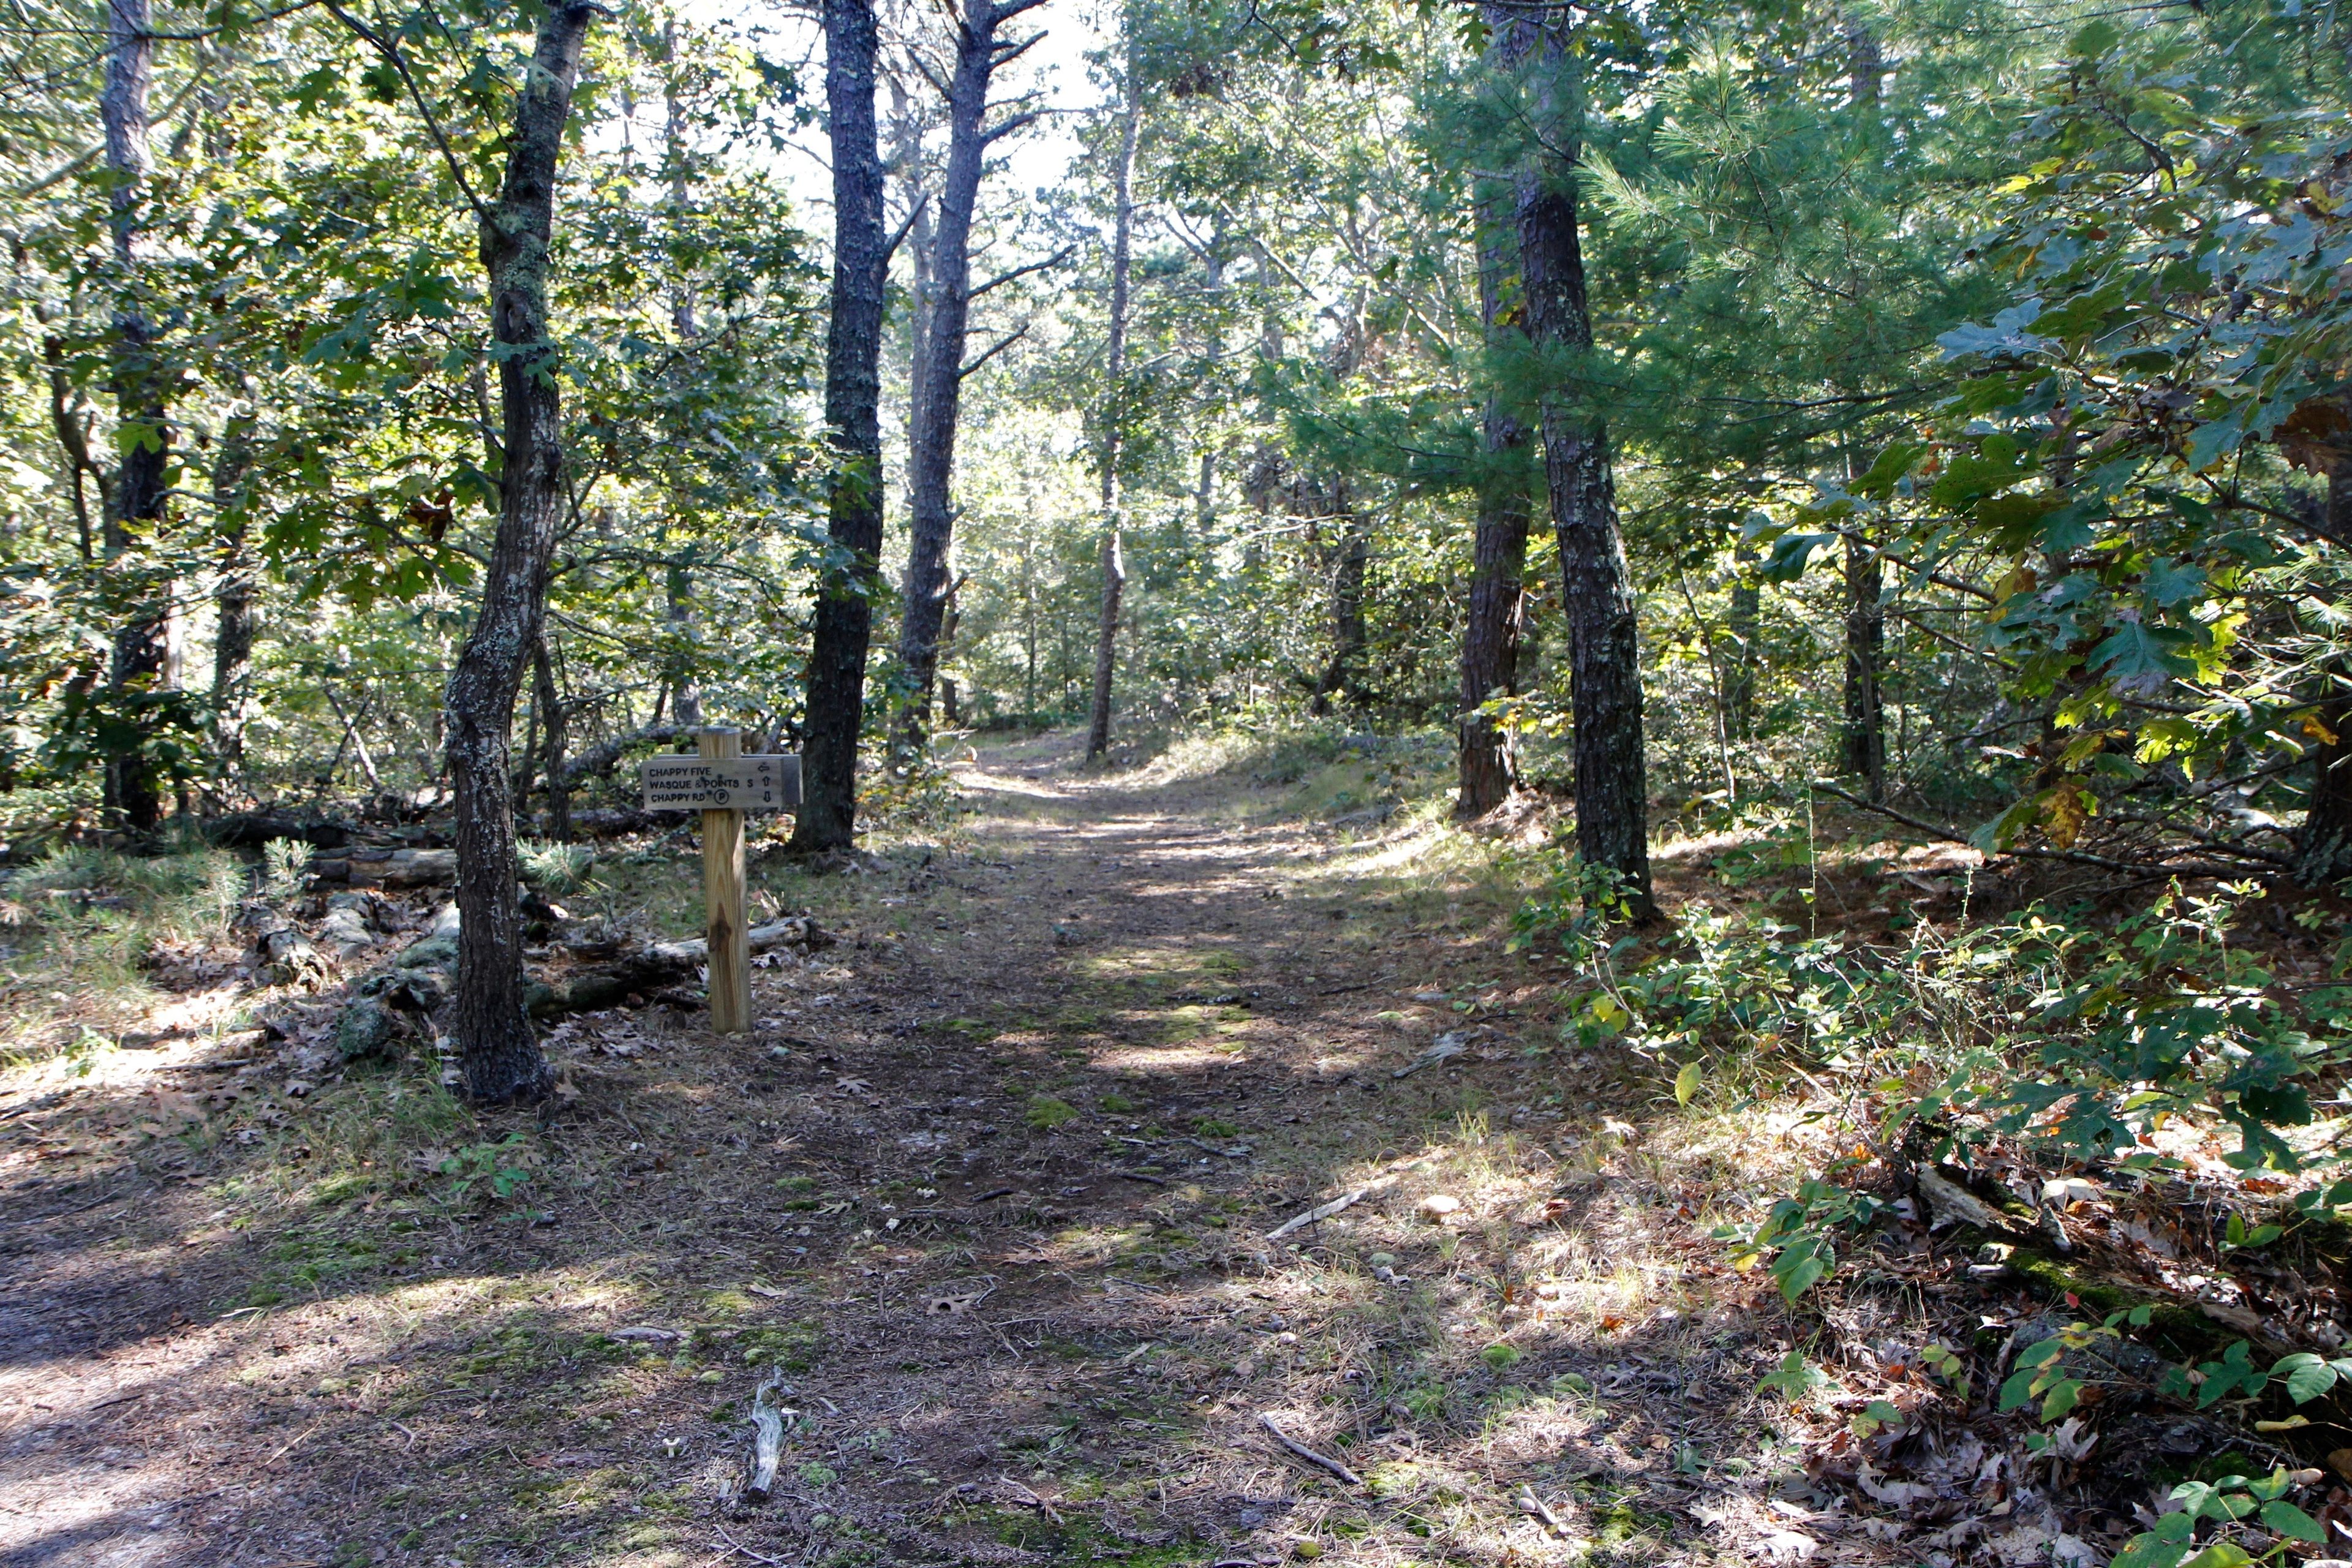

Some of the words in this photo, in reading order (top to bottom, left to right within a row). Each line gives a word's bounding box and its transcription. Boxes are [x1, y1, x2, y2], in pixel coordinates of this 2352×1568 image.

[649, 767, 688, 777] CHAPPY
[690, 767, 711, 775] FIVE
[649, 780, 692, 790] WASQUE
[704, 779, 739, 788] POINTS
[747, 779, 753, 788] S
[651, 793, 690, 802] CHAPPY
[692, 793, 705, 801] RD
